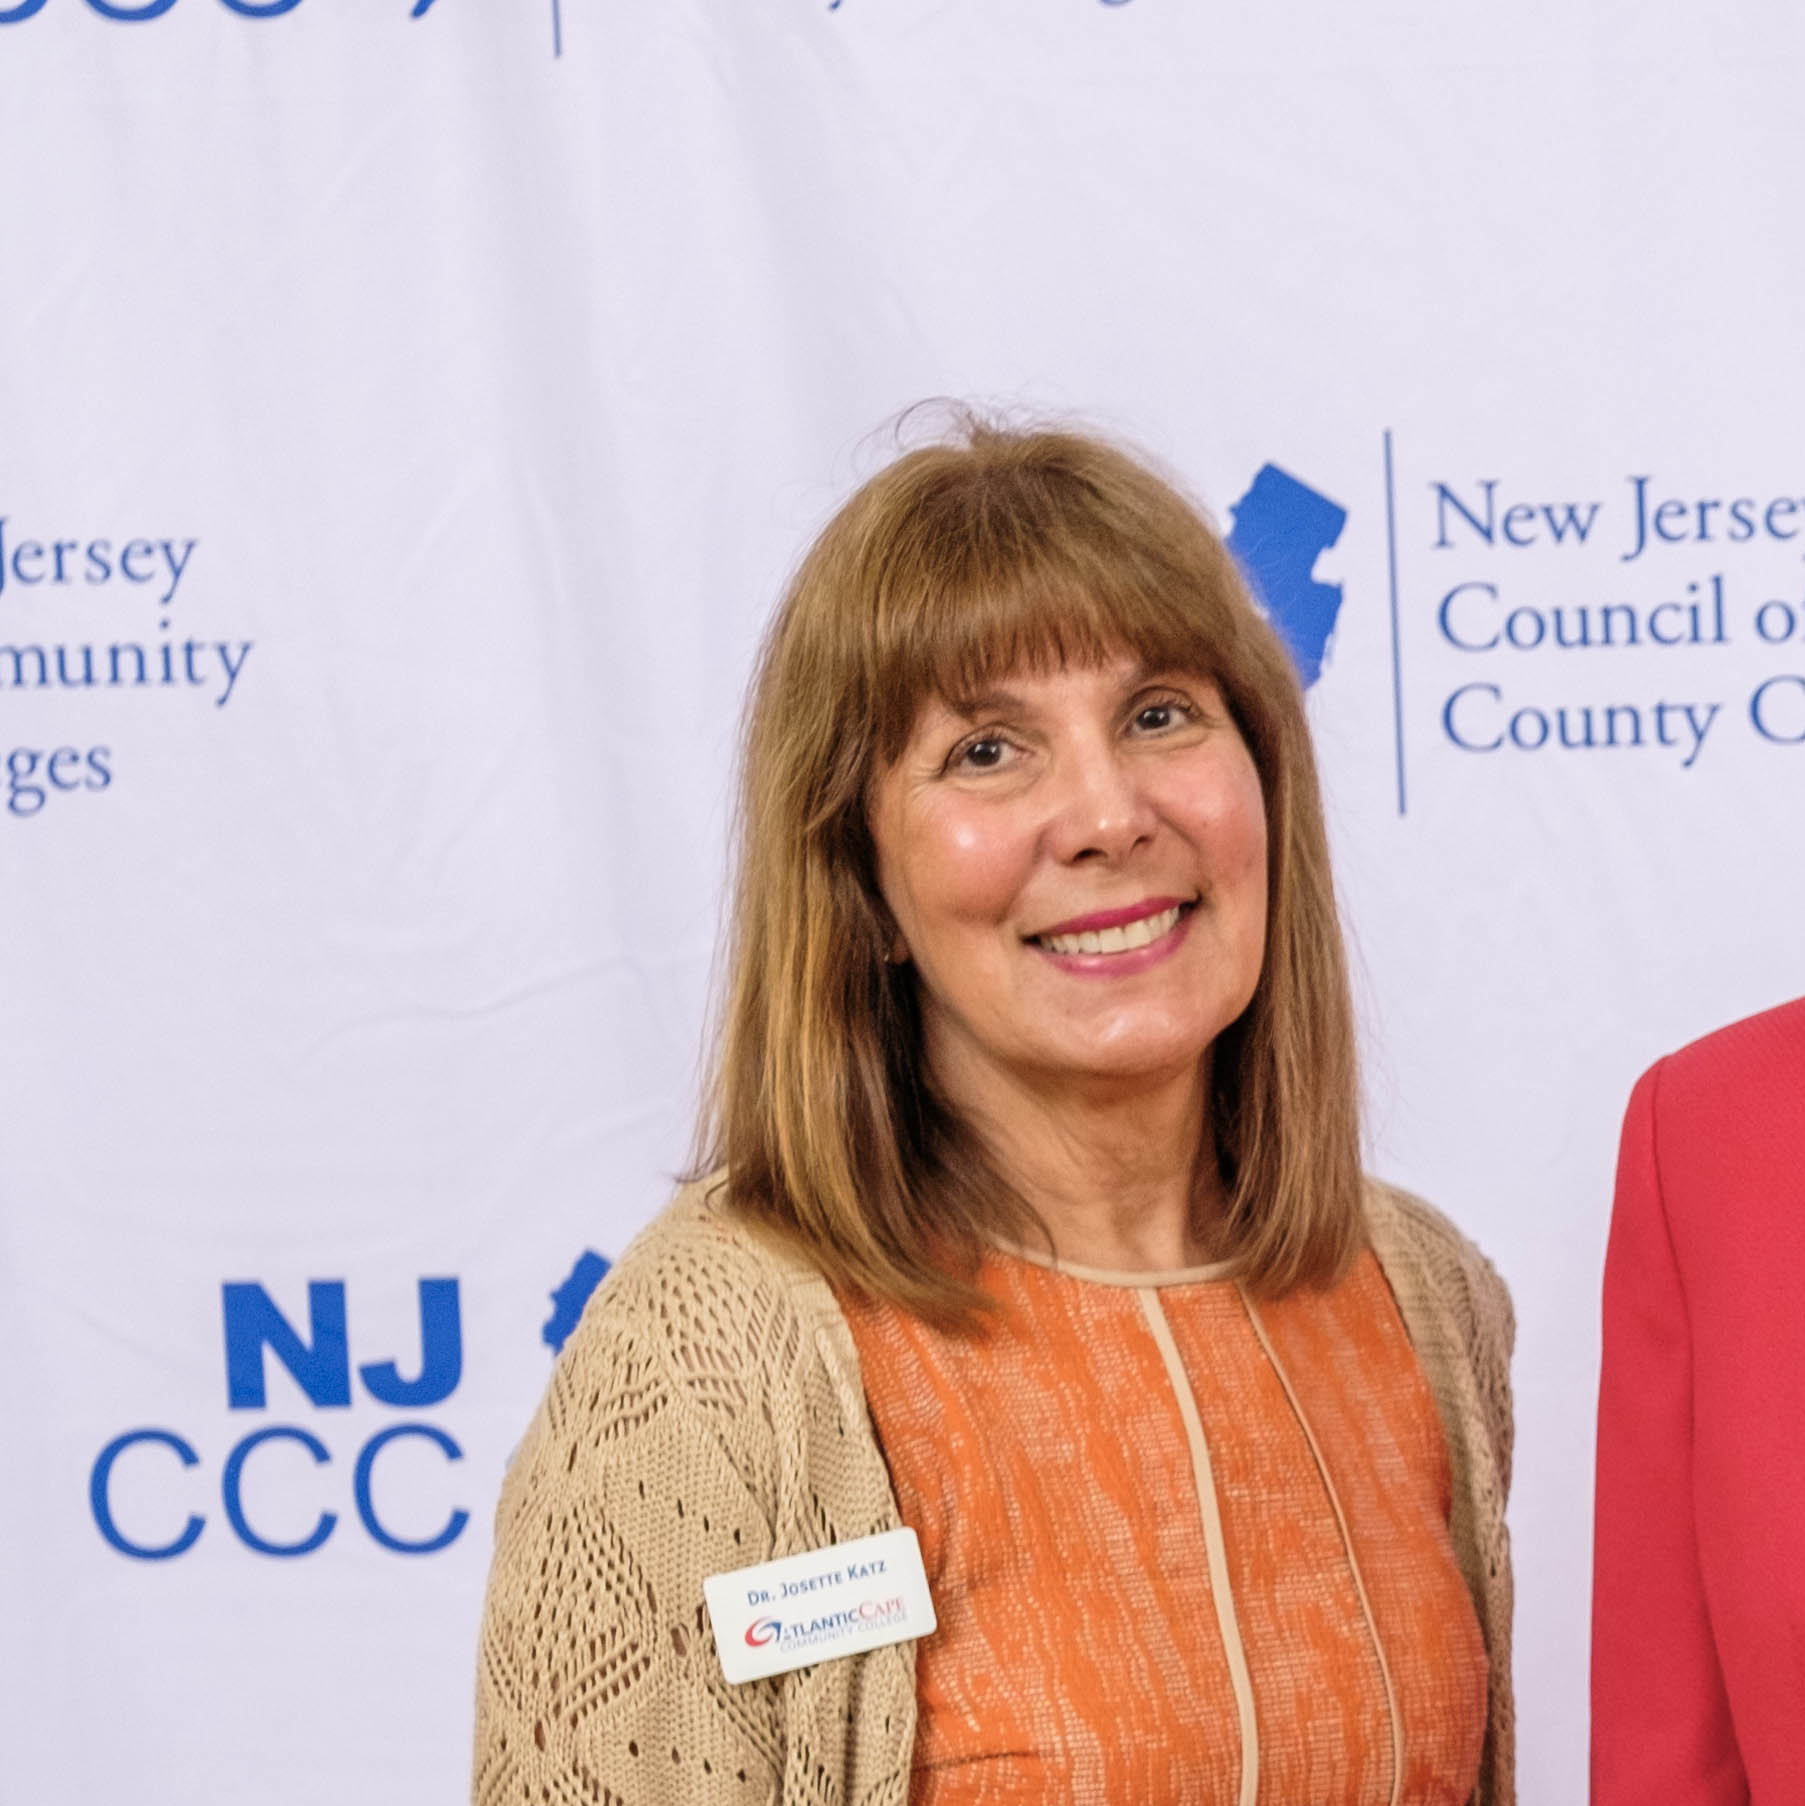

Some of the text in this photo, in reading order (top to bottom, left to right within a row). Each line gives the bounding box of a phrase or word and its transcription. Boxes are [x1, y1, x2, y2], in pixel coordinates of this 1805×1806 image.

[1428, 478, 1602, 550] New
[1437, 573, 1730, 653] Council
[1441, 681, 1723, 769] County
[220, 1275, 466, 1411] NJ
[89, 1420, 472, 1564] CCC
